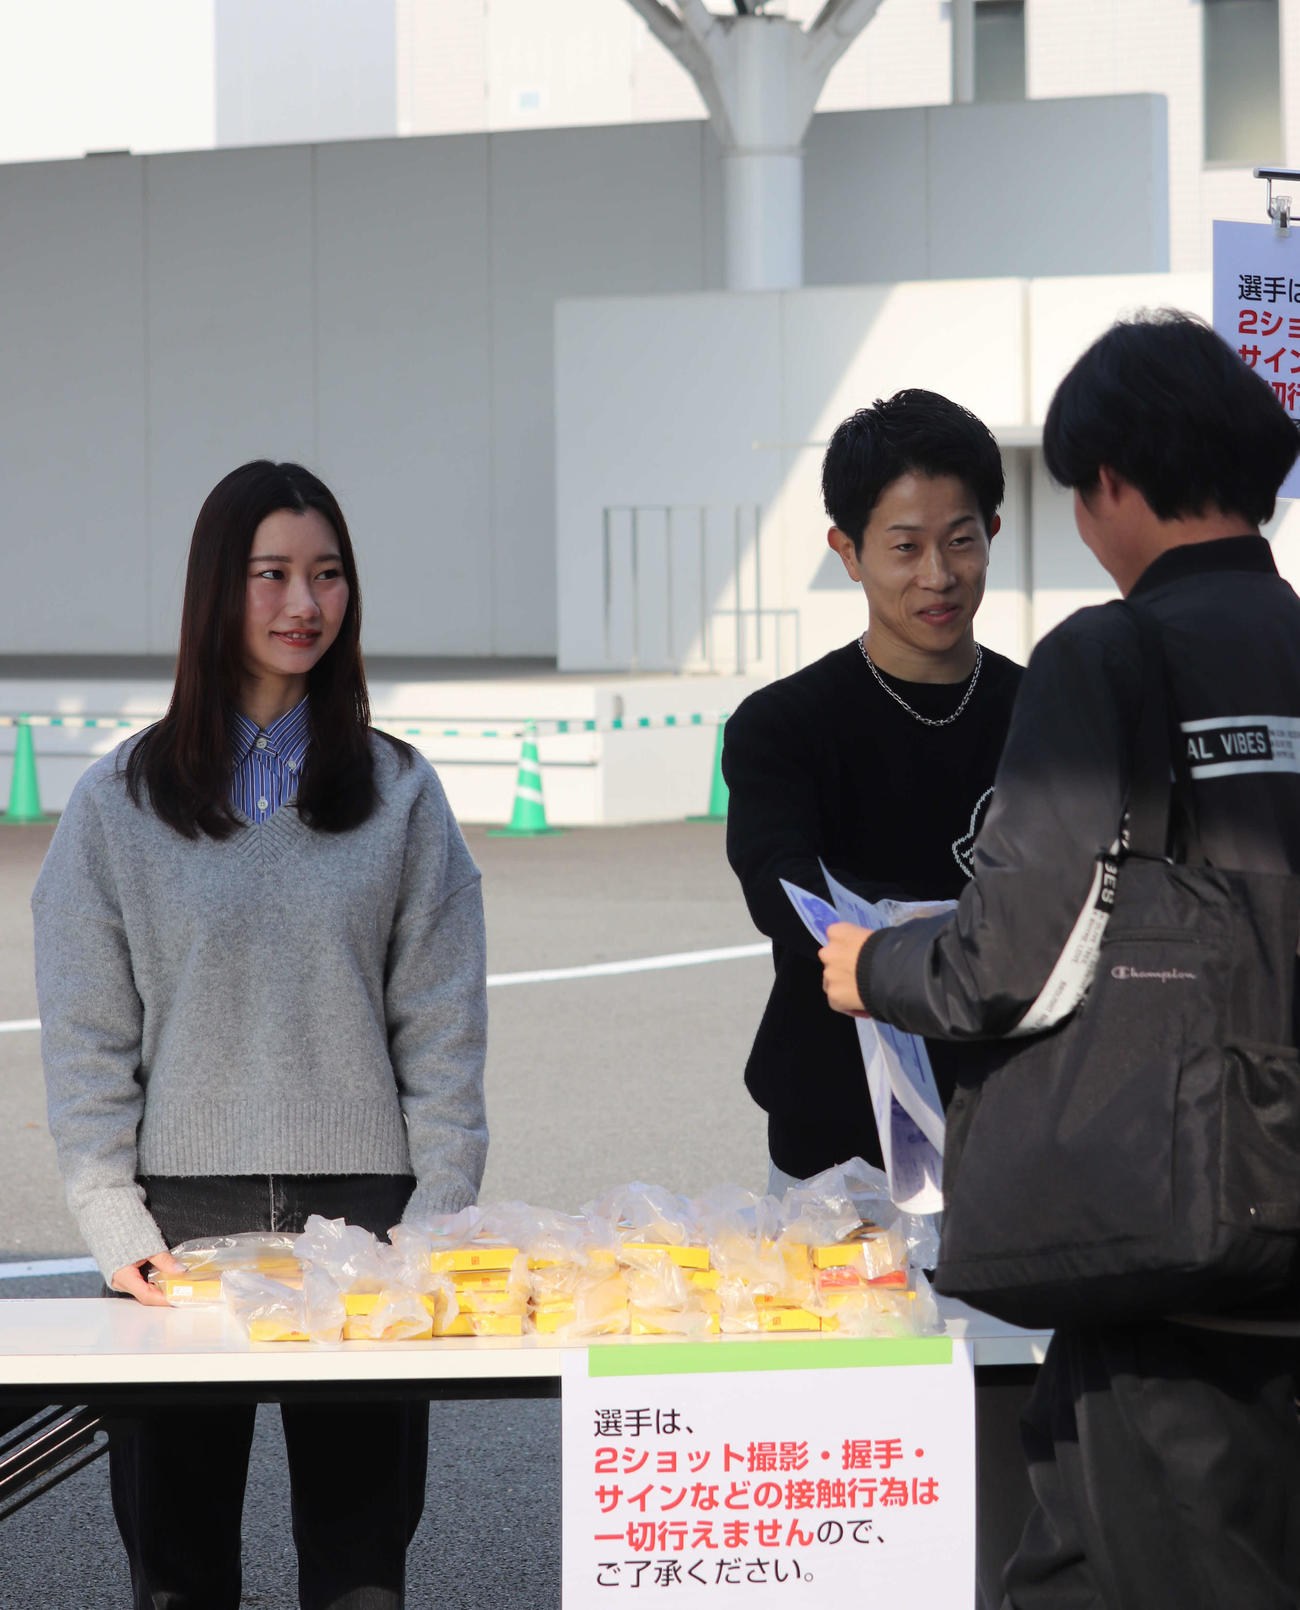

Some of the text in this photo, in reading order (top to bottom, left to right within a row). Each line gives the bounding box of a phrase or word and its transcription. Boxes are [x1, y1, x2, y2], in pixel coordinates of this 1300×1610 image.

[1220, 732, 1267, 755] VIBES
[1111, 966, 1196, 983] Champion
[594, 1408, 693, 1437] 選手は、
[595, 1438, 924, 1474] 2ショット撮影・握手・
[595, 1476, 940, 1513] サインなどの接触行為は
[596, 1557, 814, 1588] ご了承ください。
